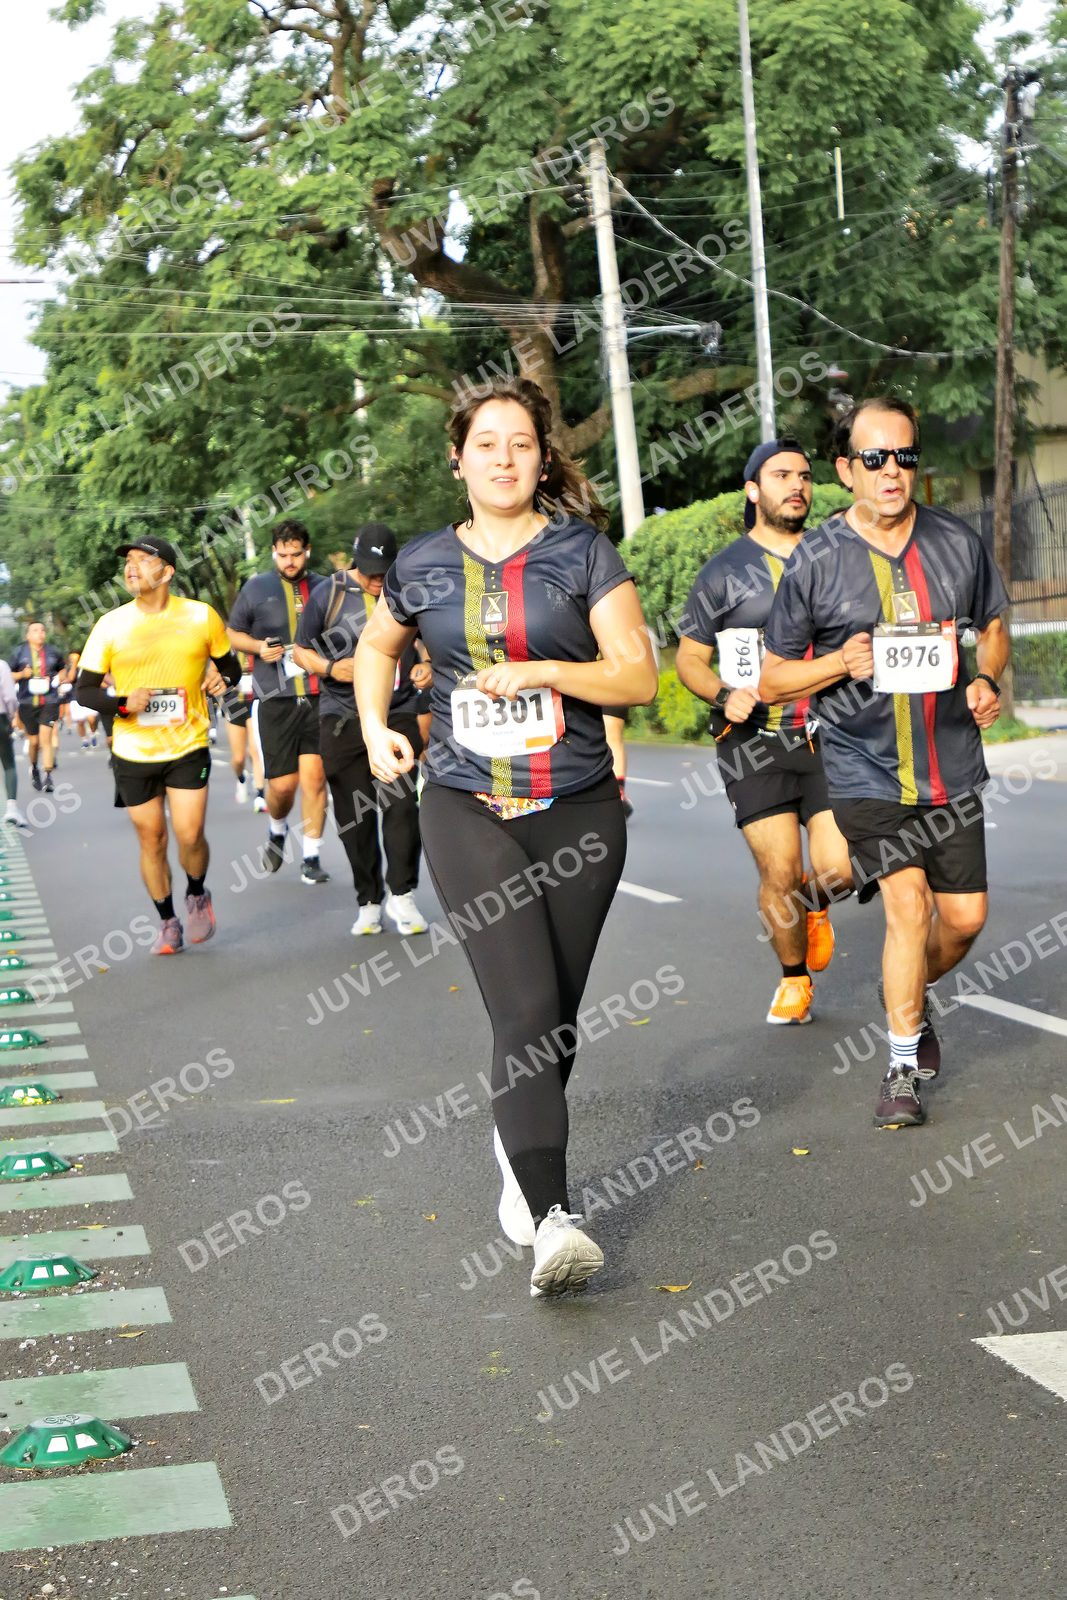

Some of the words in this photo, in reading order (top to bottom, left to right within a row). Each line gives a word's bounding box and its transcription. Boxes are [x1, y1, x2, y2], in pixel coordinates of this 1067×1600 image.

[735, 635, 753, 677] 7943
[885, 645, 940, 668] 8976
[457, 693, 544, 729] 13301
